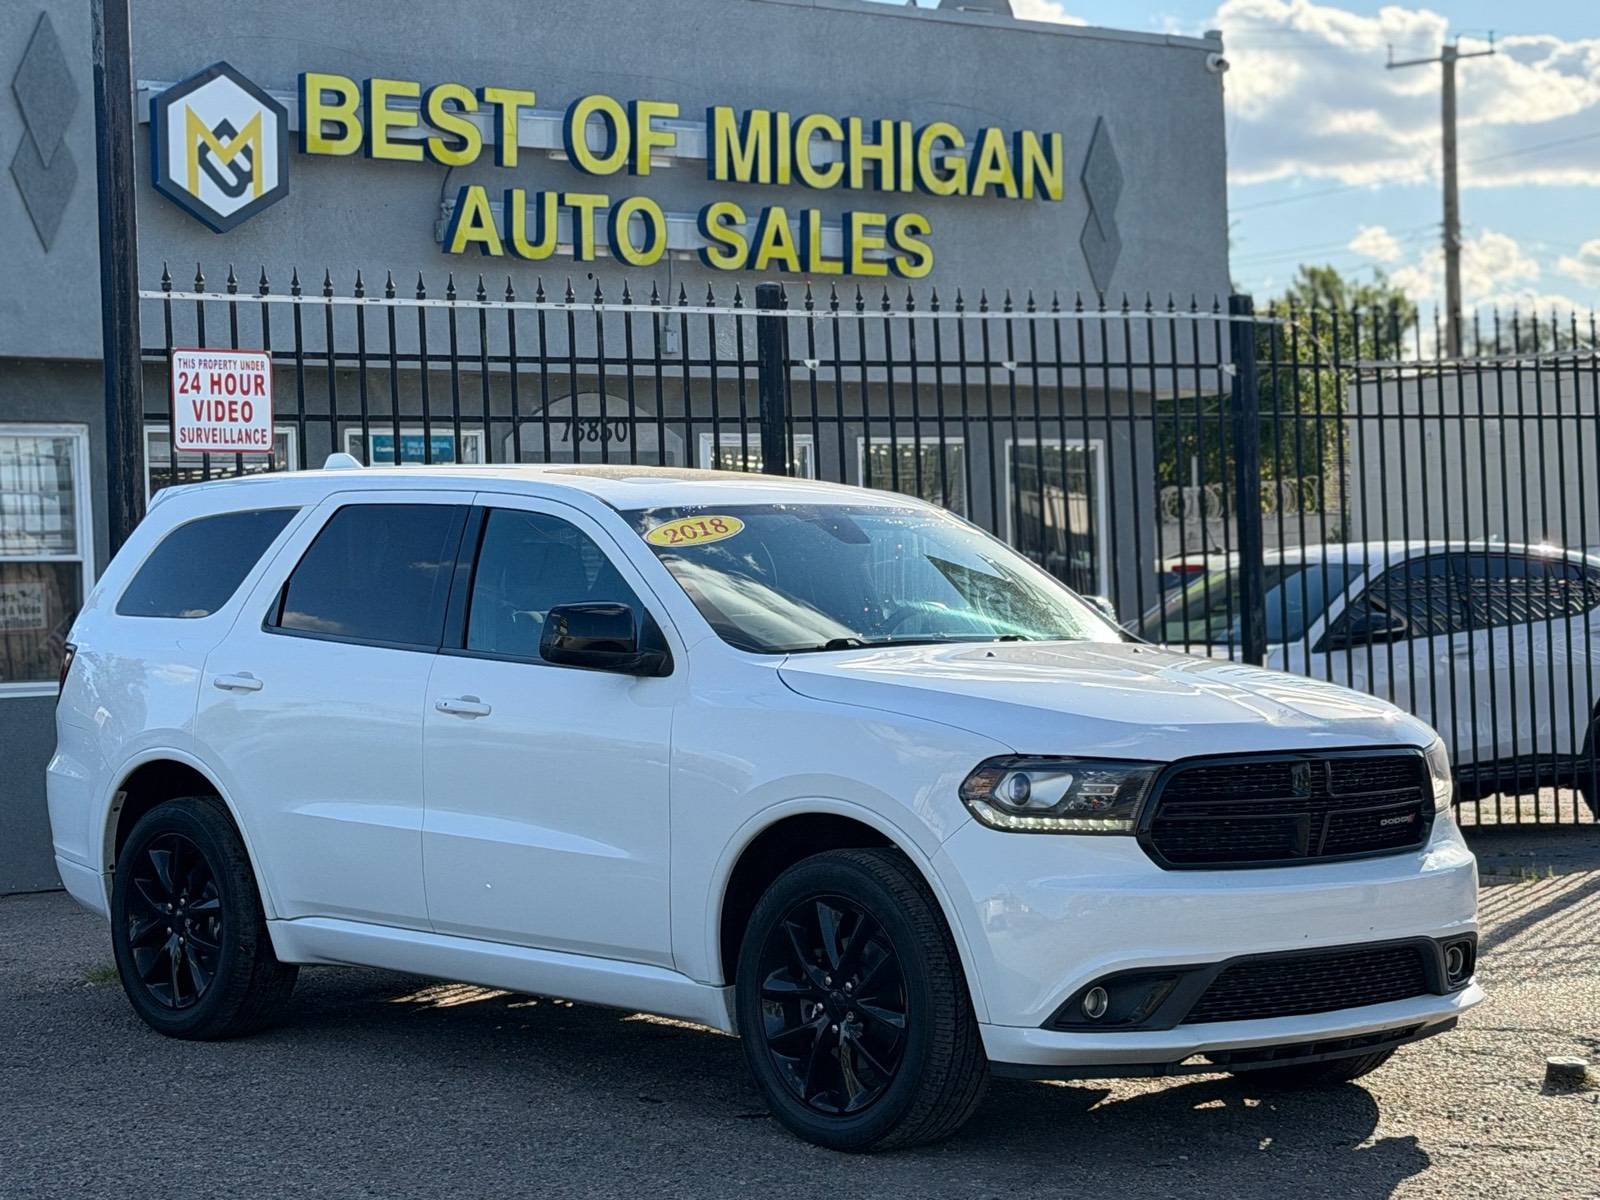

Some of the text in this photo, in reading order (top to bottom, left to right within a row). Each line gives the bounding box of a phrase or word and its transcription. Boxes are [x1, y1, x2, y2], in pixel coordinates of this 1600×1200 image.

[300, 72, 1063, 200] BEST OF MICHIGAN
[443, 185, 934, 278] AUTO SALES
[178, 358, 265, 371] THIS PROPERTY UNDER
[178, 371, 266, 396] 24 HOUR
[192, 400, 253, 423] VIDEO
[180, 427, 268, 445] SURVEILLANCE
[663, 518, 729, 543] 2018
